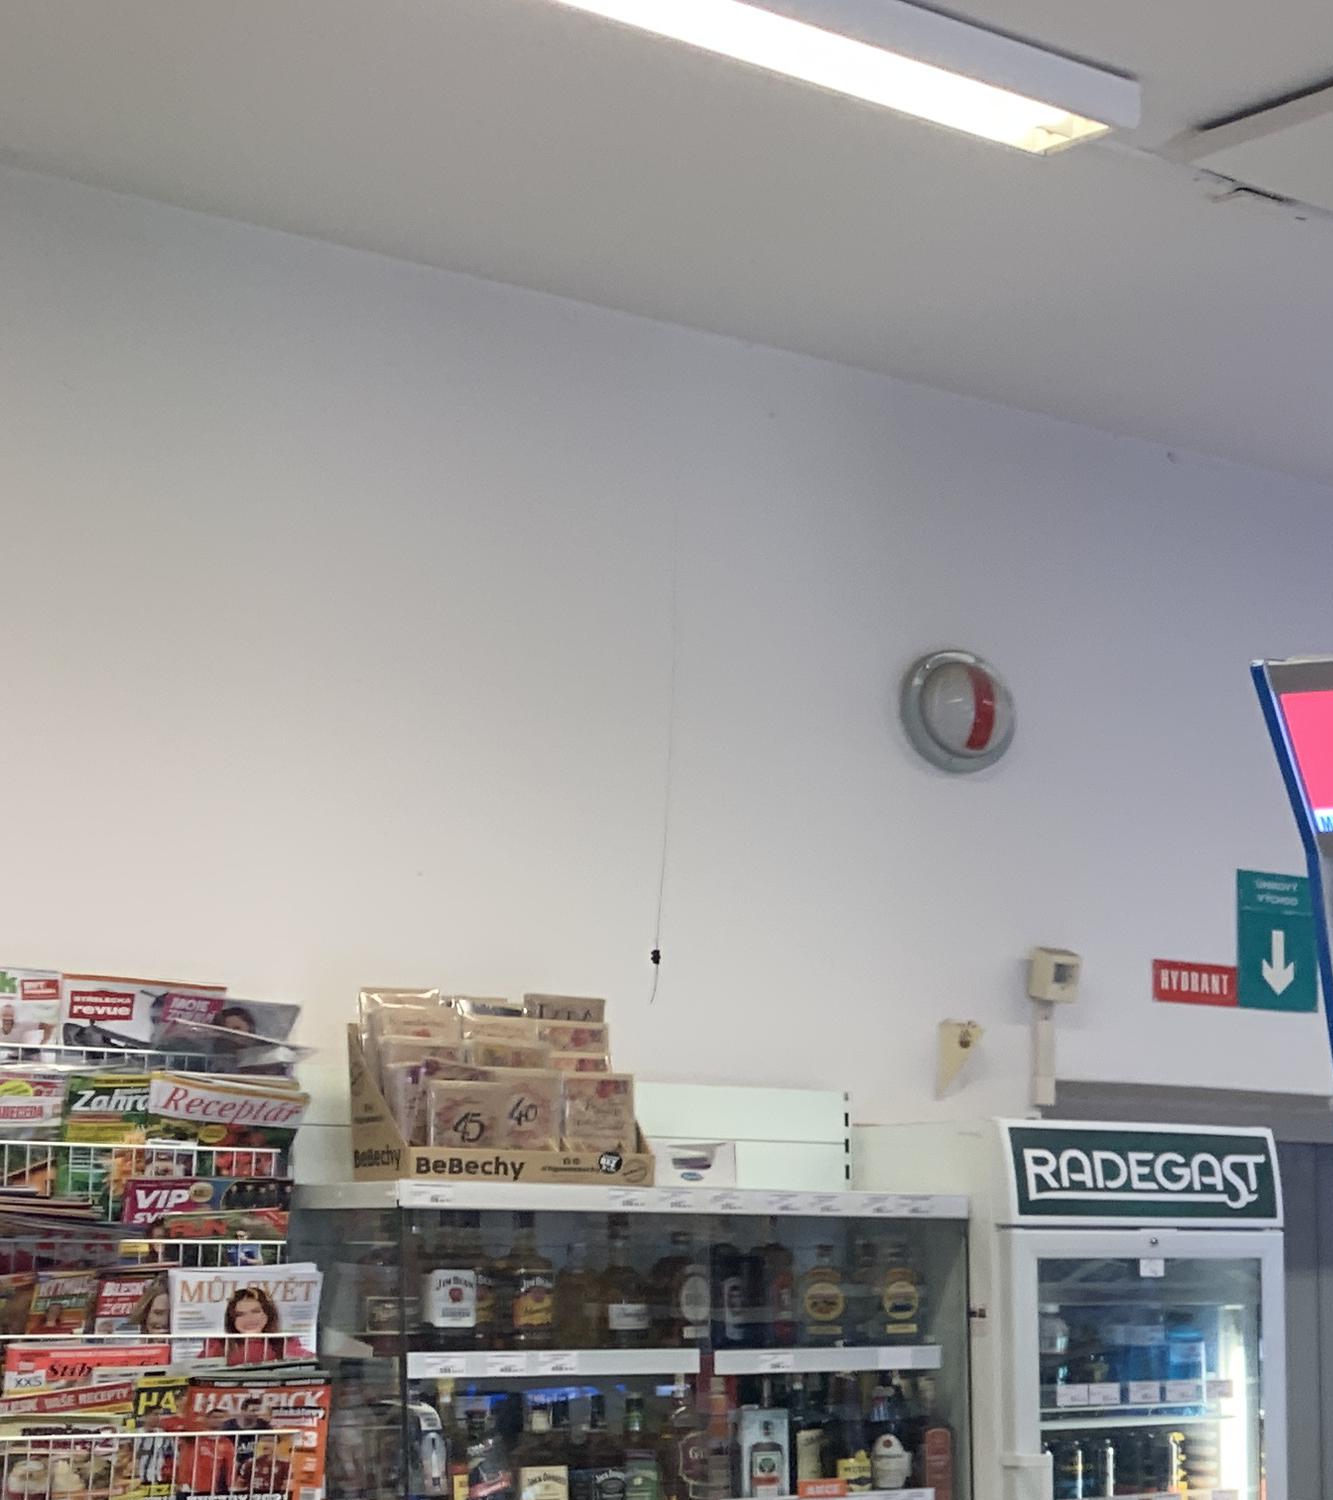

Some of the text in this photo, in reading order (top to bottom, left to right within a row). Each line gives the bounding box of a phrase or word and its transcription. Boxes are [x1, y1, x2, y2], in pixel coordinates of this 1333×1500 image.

[1160, 969, 1229, 995] HYDRANT
[73, 1005, 131, 1016] revue
[508, 1097, 538, 1126] 40
[453, 1111, 486, 1143] 45
[415, 1155, 526, 1181] BeBechy
[1022, 1147, 1266, 1209] RADEGAST
[136, 1189, 190, 1209] VIP
